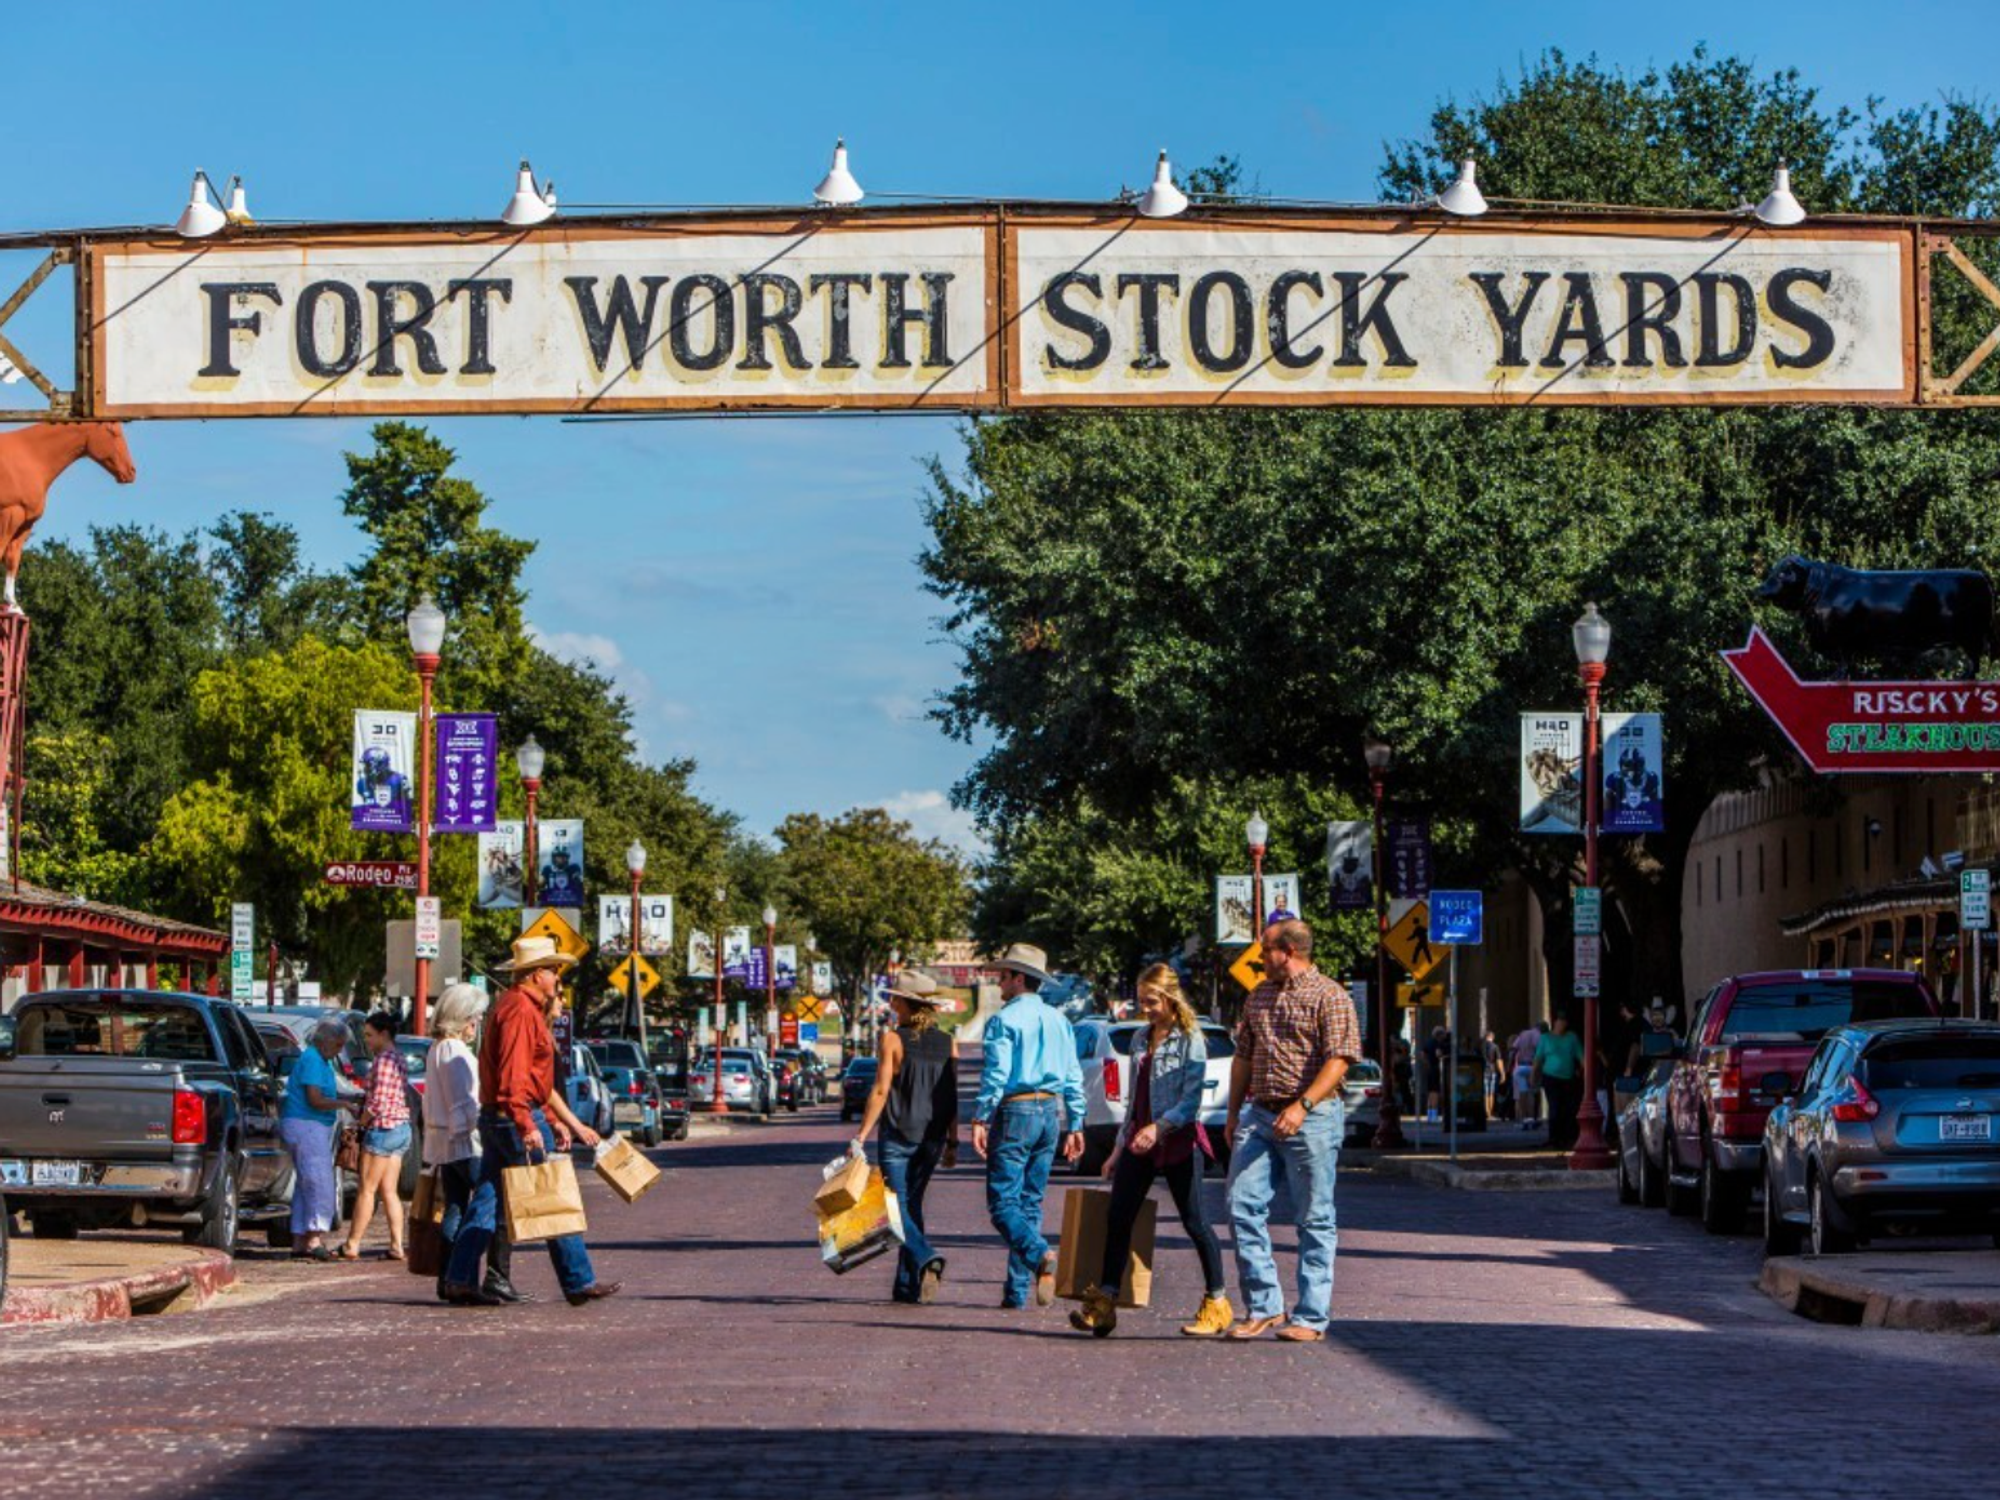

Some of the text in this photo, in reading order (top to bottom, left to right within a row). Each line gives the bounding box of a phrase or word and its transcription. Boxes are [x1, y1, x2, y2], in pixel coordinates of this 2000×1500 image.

[194, 273, 955, 382] FORT WORTH
[1042, 267, 1836, 379] STOCK YARDS
[1853, 688, 1999, 713] RISCKY'S
[346, 864, 392, 882] Rodeo
